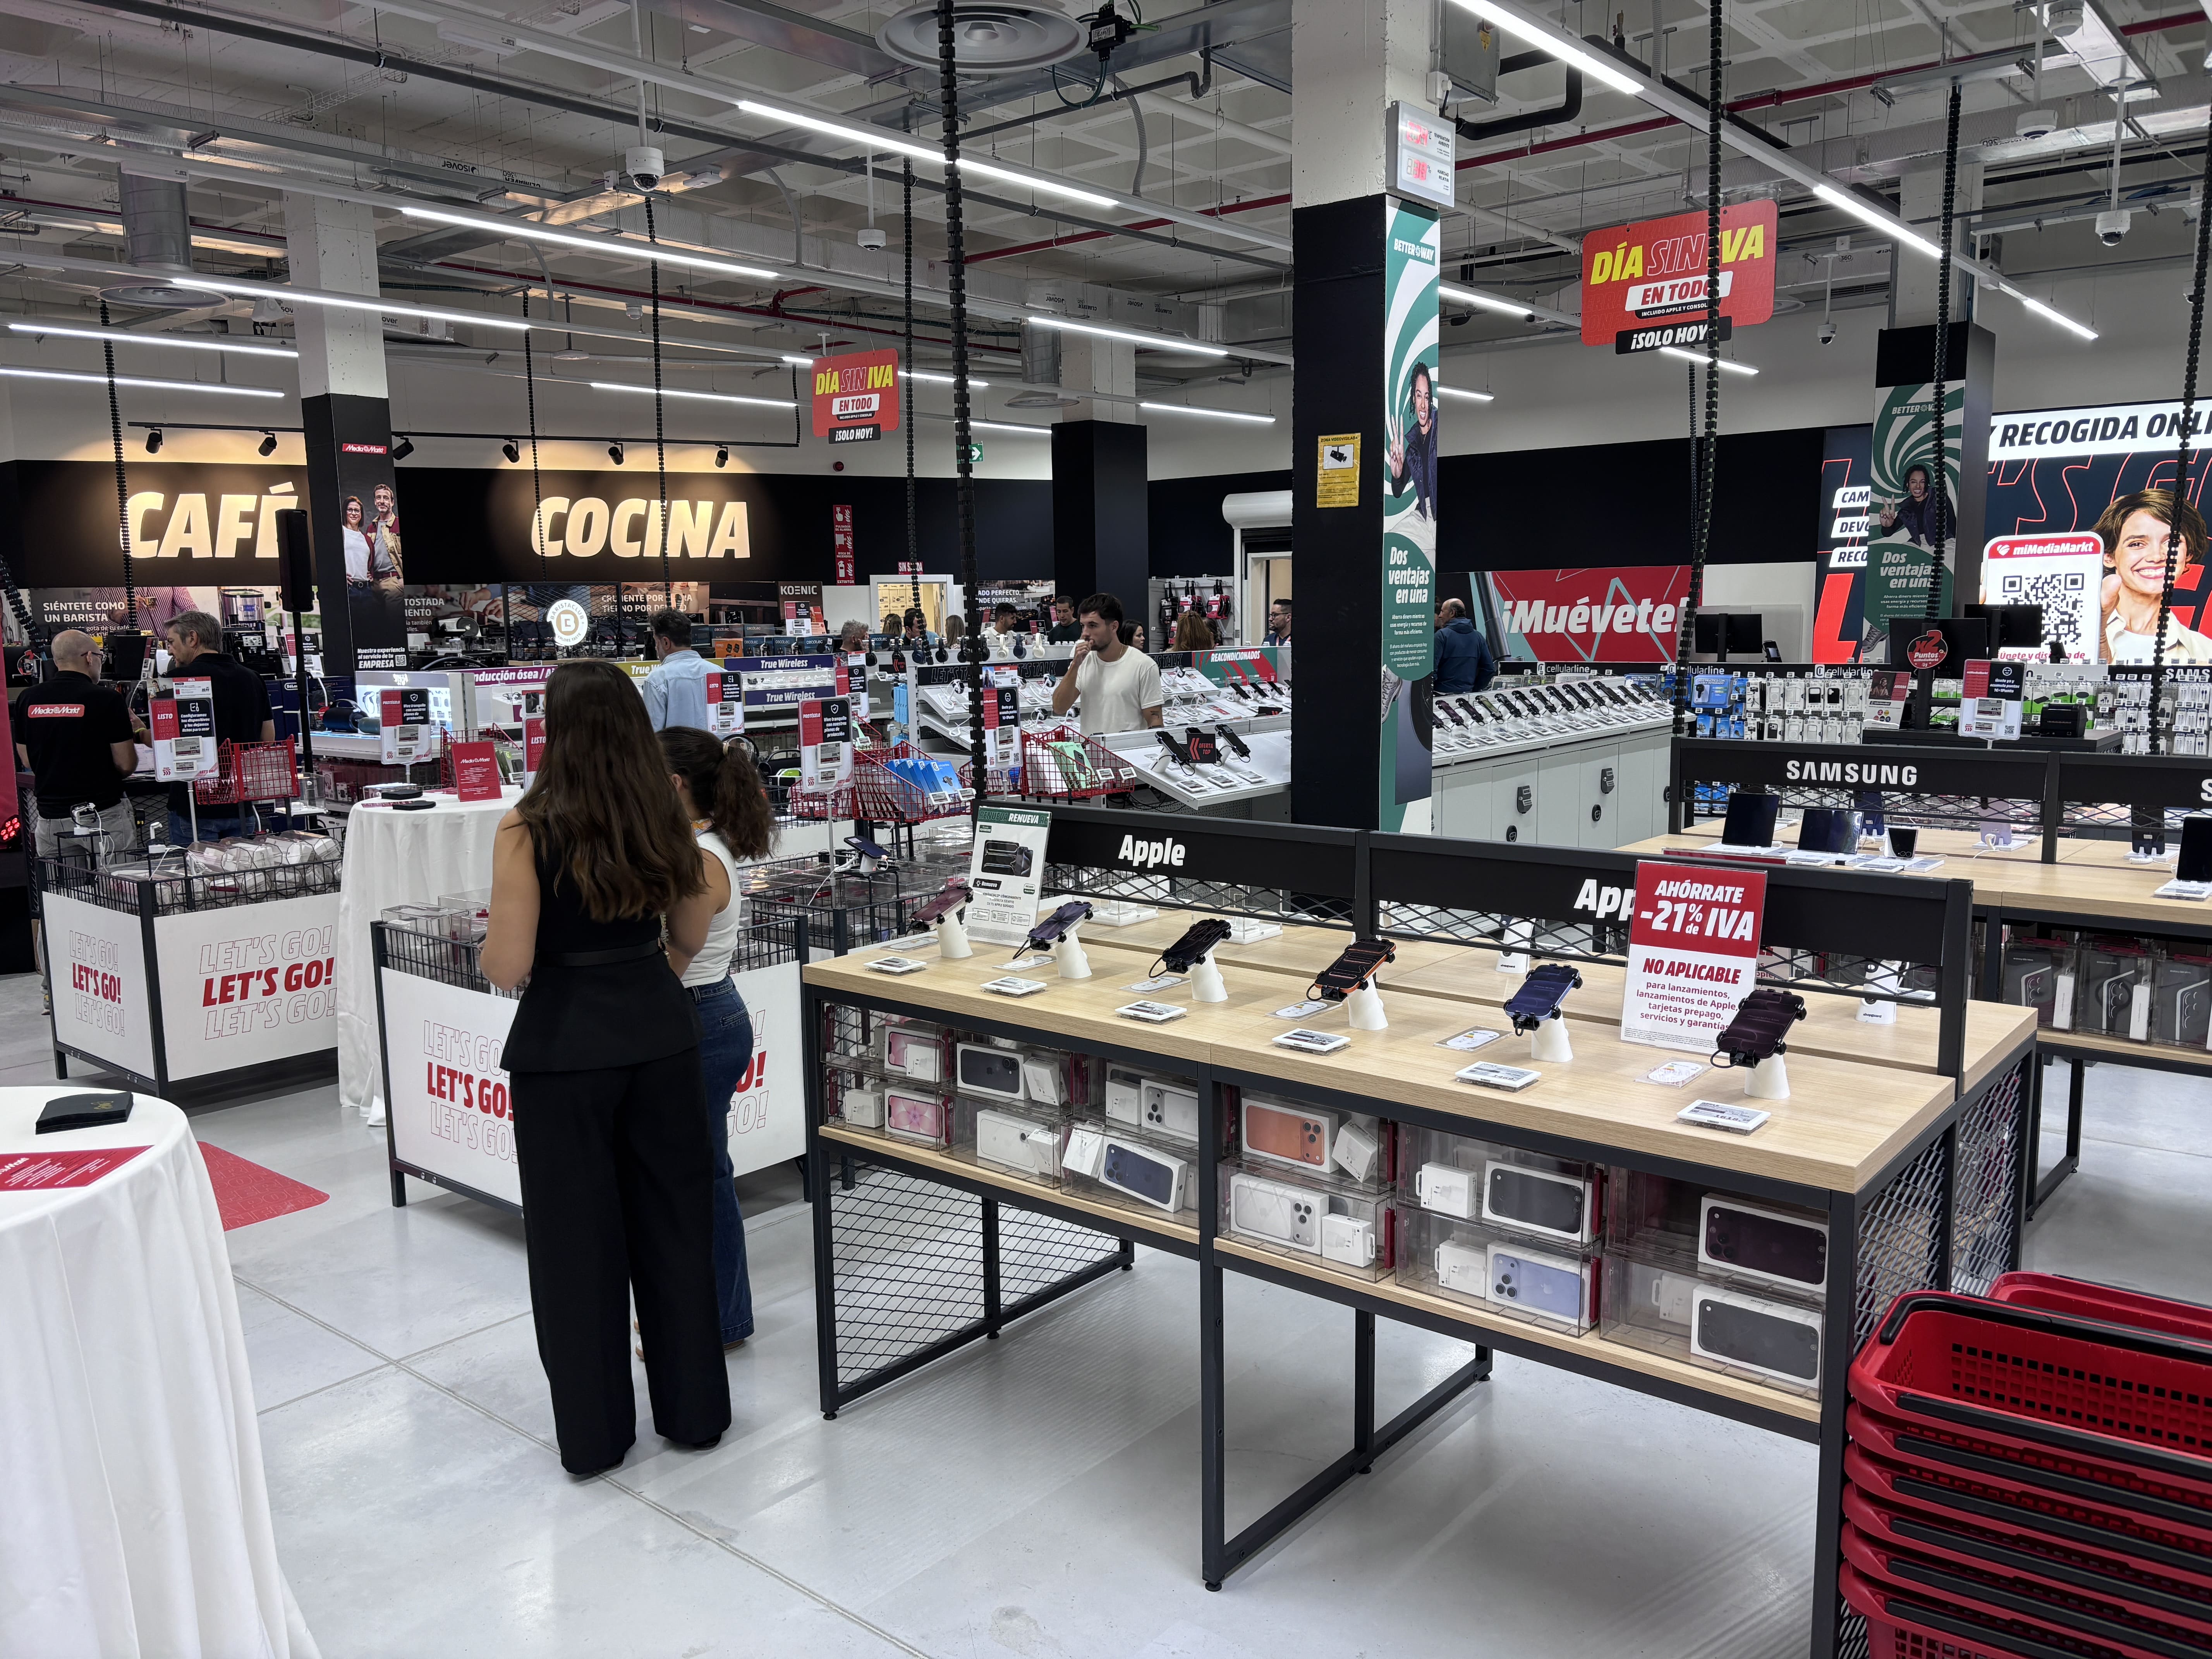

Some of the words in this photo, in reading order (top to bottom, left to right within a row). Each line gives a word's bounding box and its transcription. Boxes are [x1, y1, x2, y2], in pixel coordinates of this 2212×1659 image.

[1434, 133, 1449, 142] TEMPERATURA
[1394, 238, 1415, 256] BETTER
[1420, 244, 1434, 261] WAY
[1590, 242, 1643, 285] DÍA
[1647, 233, 1706, 276] SIN
[1707, 224, 1764, 266] VA
[1641, 286, 1665, 306] EN
[1642, 309, 1665, 317] INCLUIDO
[1630, 328, 1674, 350] ¡SOLO
[1675, 324, 1713, 343] HOY
[816, 368, 839, 395] DÍA
[841, 367, 866, 392] SIN
[867, 364, 893, 389] IVA
[839, 400, 850, 412] EN
[851, 397, 872, 411] TODO
[1892, 405, 1920, 414] BETTER
[835, 429, 854, 441] ¡SOLO
[855, 428, 873, 440] HOY!
[1999, 415, 2138, 447] RECOGIDA
[120, 481, 298, 559] CAFÉ
[531, 496, 750, 558] COCINA
[1390, 547, 1408, 565] Dos
[1882, 552, 1907, 563] Dos
[2013, 542, 2094, 556] miMediaMarkt
[1389, 566, 1430, 588] ventajas
[1889, 579, 1907, 588] en
[780, 586, 817, 595] KOENIC
[1396, 589, 1408, 603] en
[1410, 589, 1428, 603] una
[43, 601, 93, 611] SIÉNTETE
[95, 602, 125, 610] COMO
[404, 598, 445, 606] TOSTADA
[550, 602, 584, 620] BARISTACLUB
[44, 614, 60, 622] UN
[64, 614, 108, 622] BARISTA
[1503, 596, 1690, 634] ¡Muévete!
[1914, 631, 1941, 652] x2
[359, 660, 394, 669] EMPRESA
[761, 660, 777, 669] True
[778, 659, 808, 668] Wireless
[1211, 650, 1261, 662] REACONDICIONADOS
[517, 668, 538, 680] ósea
[631, 665, 649, 675] True
[1546, 665, 1590, 674] cellularline
[766, 693, 783, 702] True
[785, 691, 815, 701] Wireless
[1786, 760, 1917, 785] SAMSUNG
[979, 810, 1008, 821] RENUEVA
[1008, 813, 1039, 824] RENUEVA
[1118, 835, 1185, 868] Apple
[1574, 879, 1635, 921] App
[1654, 879, 1745, 904] AHÓRRATE
[1685, 923, 1699, 935] de
[1704, 907, 1754, 941] IVA
[70, 931, 99, 965] LET'S
[99, 942, 118, 972] GO!
[199, 935, 277, 974] LET'S
[281, 925, 332, 959] GO!
[1643, 958, 1664, 975] NO
[1665, 961, 1741, 985] APLICABLE
[72, 962, 100, 996] LET'S
[101, 973, 121, 1004] GO!
[203, 967, 279, 1008] LET'S
[284, 957, 335, 992] GO!
[1646, 982, 1666, 992] para
[1668, 982, 1731, 1000] lanzamientos,
[1637, 990, 1695, 1005] lanzamientos
[1697, 997, 1709, 1007] de
[1711, 998, 1739, 1012] Apple,
[76, 993, 104, 1027] LET'S
[105, 1006, 125, 1037] GO!
[205, 999, 282, 1040] LET'S
[287, 988, 337, 1024] GO!
[1640, 1012, 1678, 1023] servicios
[1680, 1018, 1686, 1026] y
[1648, 1002, 1682, 1014] tarjetas
[1685, 1006, 1723, 1021] prepago,
[424, 1020, 471, 1068] LET'S
[735, 1051, 767, 1094] O!
[427, 1061, 474, 1109] LET'S
[431, 1101, 478, 1150] LET'S
